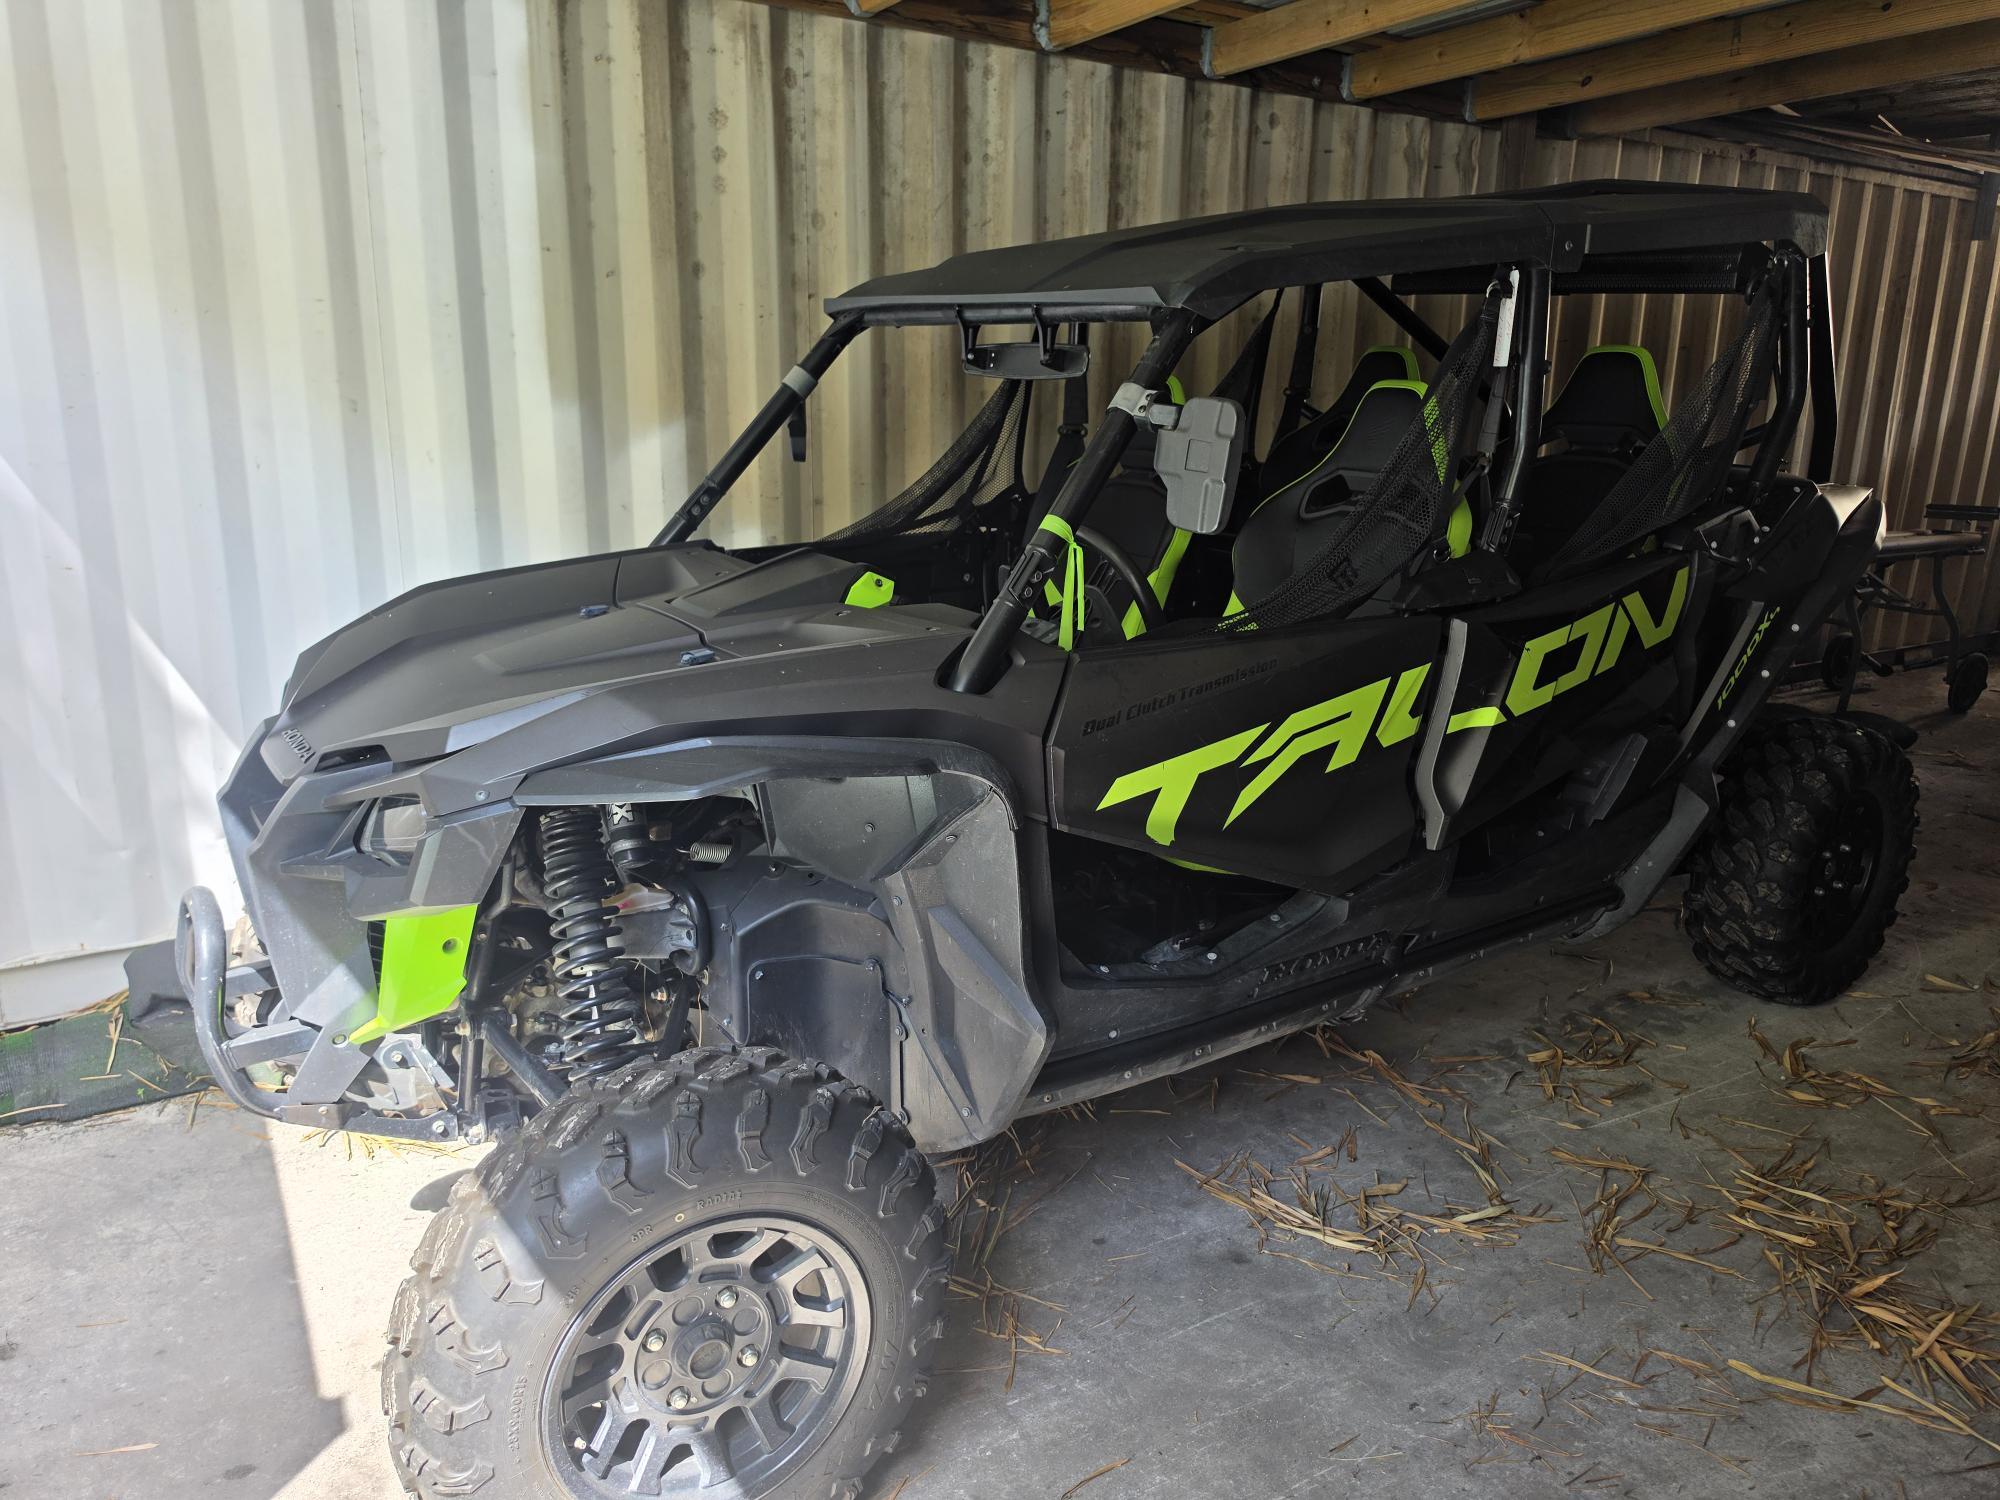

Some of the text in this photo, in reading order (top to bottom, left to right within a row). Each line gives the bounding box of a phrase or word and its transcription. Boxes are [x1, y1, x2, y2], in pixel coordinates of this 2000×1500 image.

[1082, 657, 1279, 737] Dual Clutch Transmission
[1096, 566, 1690, 846] TALON
[281, 727, 317, 764] HONDA
